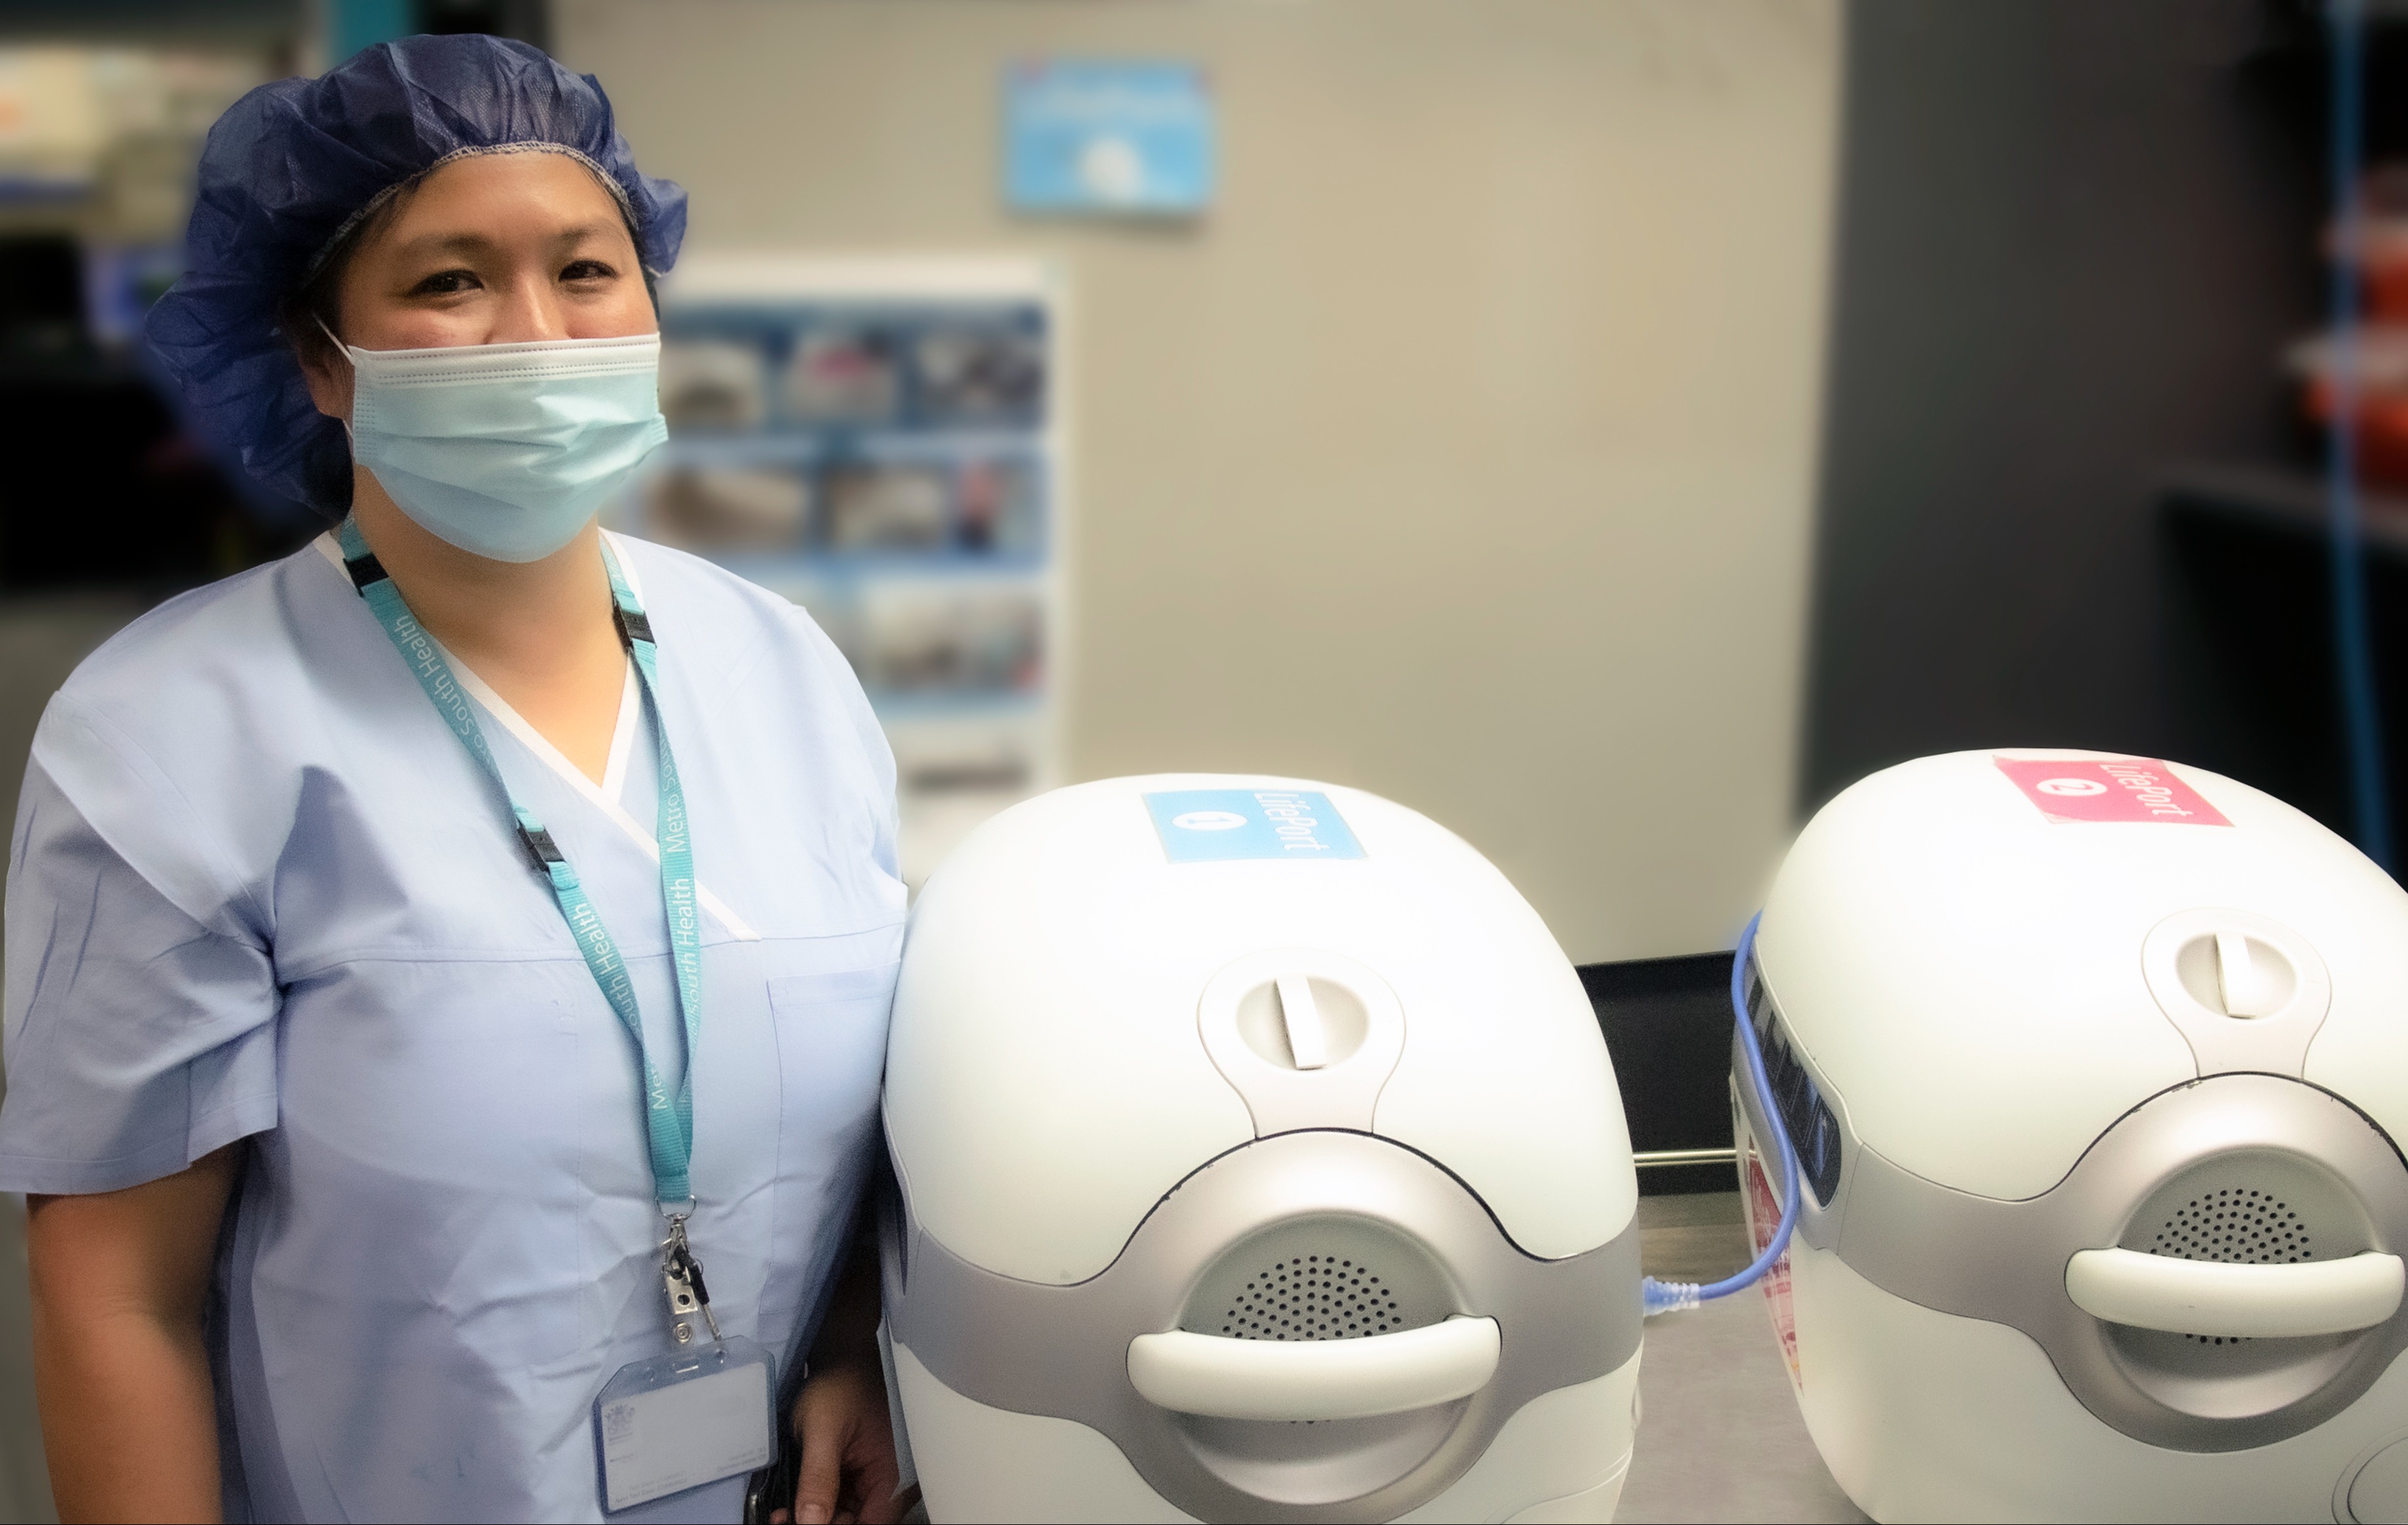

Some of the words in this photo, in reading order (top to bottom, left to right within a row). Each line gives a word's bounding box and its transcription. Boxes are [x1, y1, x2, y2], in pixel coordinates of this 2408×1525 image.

[394, 615, 441, 678] Health
[434, 674, 474, 736] South
[2100, 763, 2194, 817] LifePort
[665, 793, 686, 853] Metro
[1254, 792, 1331, 851] LifePort
[573, 903, 618, 976] Health
[670, 878, 694, 947] Health
